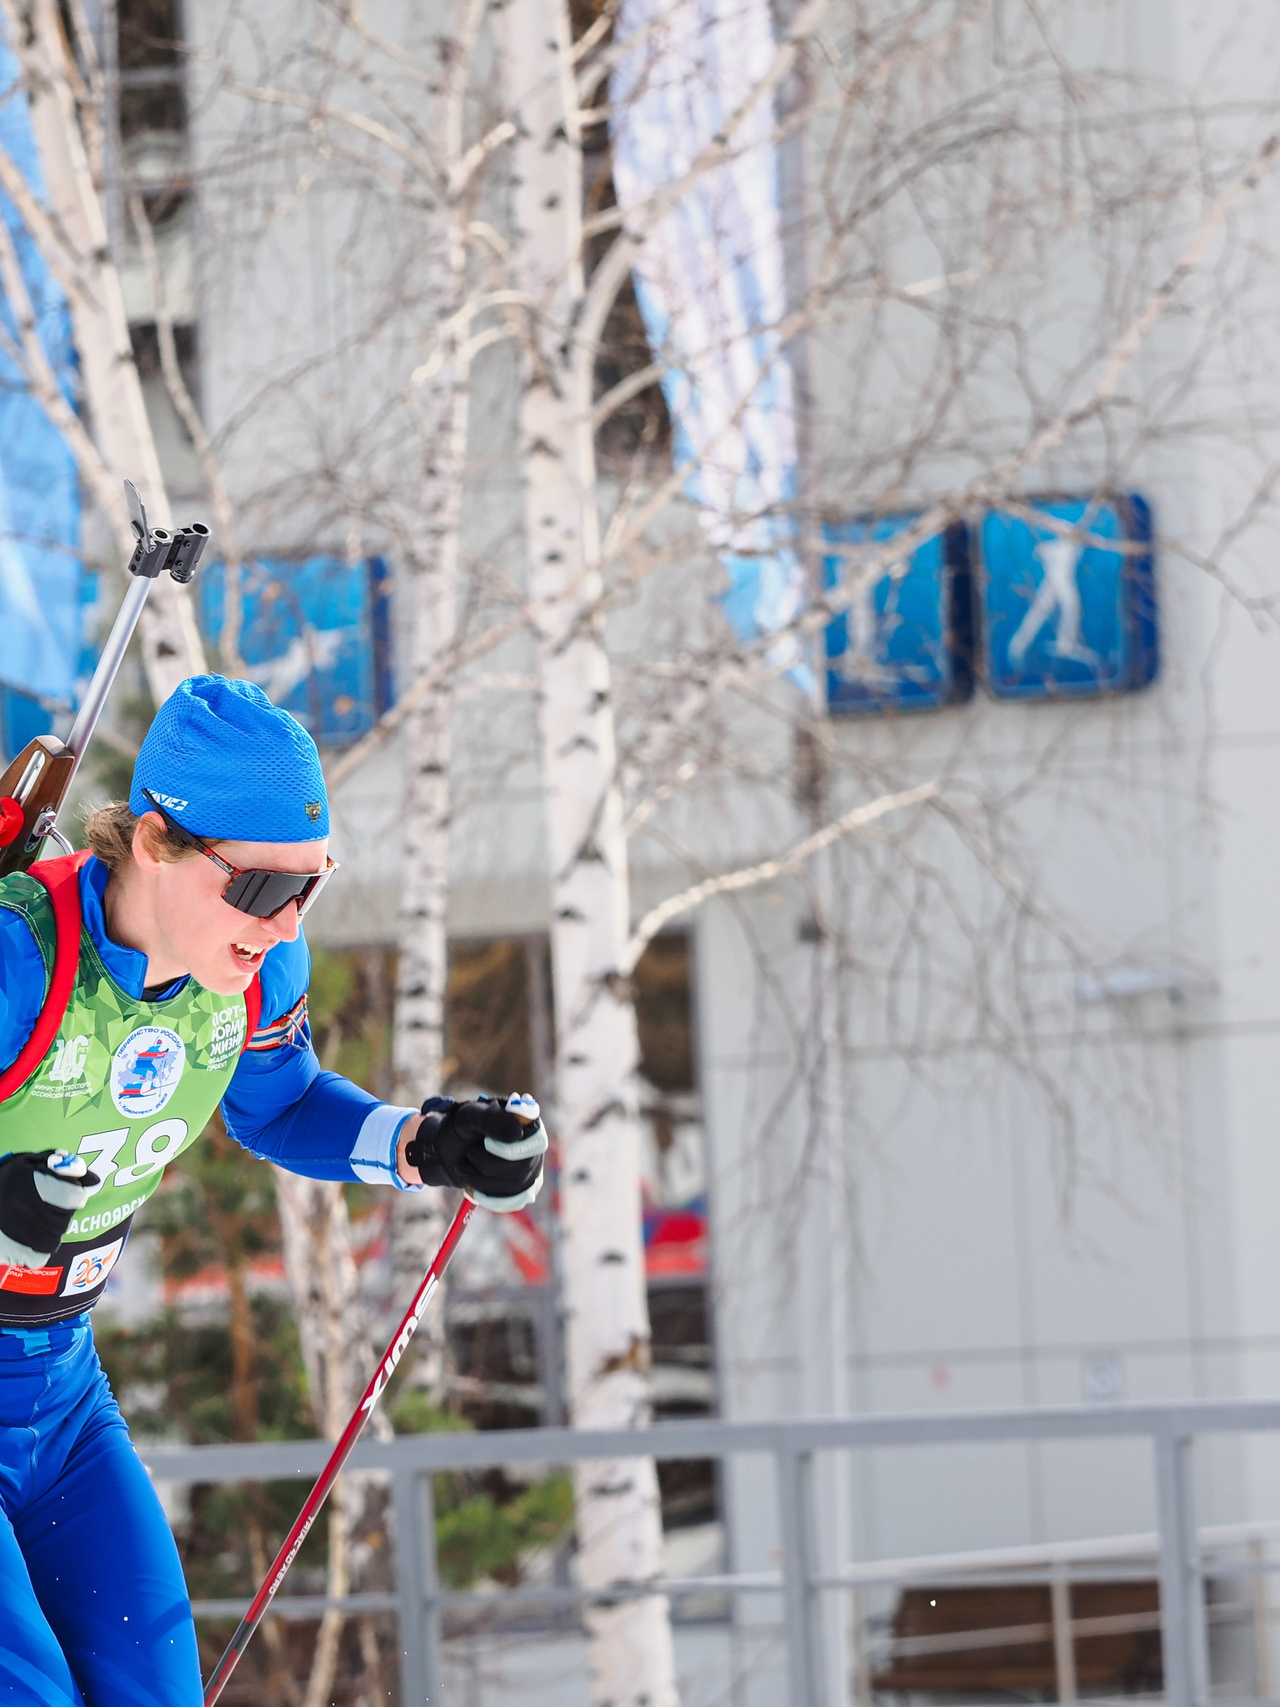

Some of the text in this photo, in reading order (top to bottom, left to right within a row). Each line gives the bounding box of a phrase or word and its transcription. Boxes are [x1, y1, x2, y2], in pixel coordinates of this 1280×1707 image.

[117, 1027, 182, 1058] ПЕРВЕНСТВО РОССИИ
[294, 1514, 315, 1548] TRIAC
